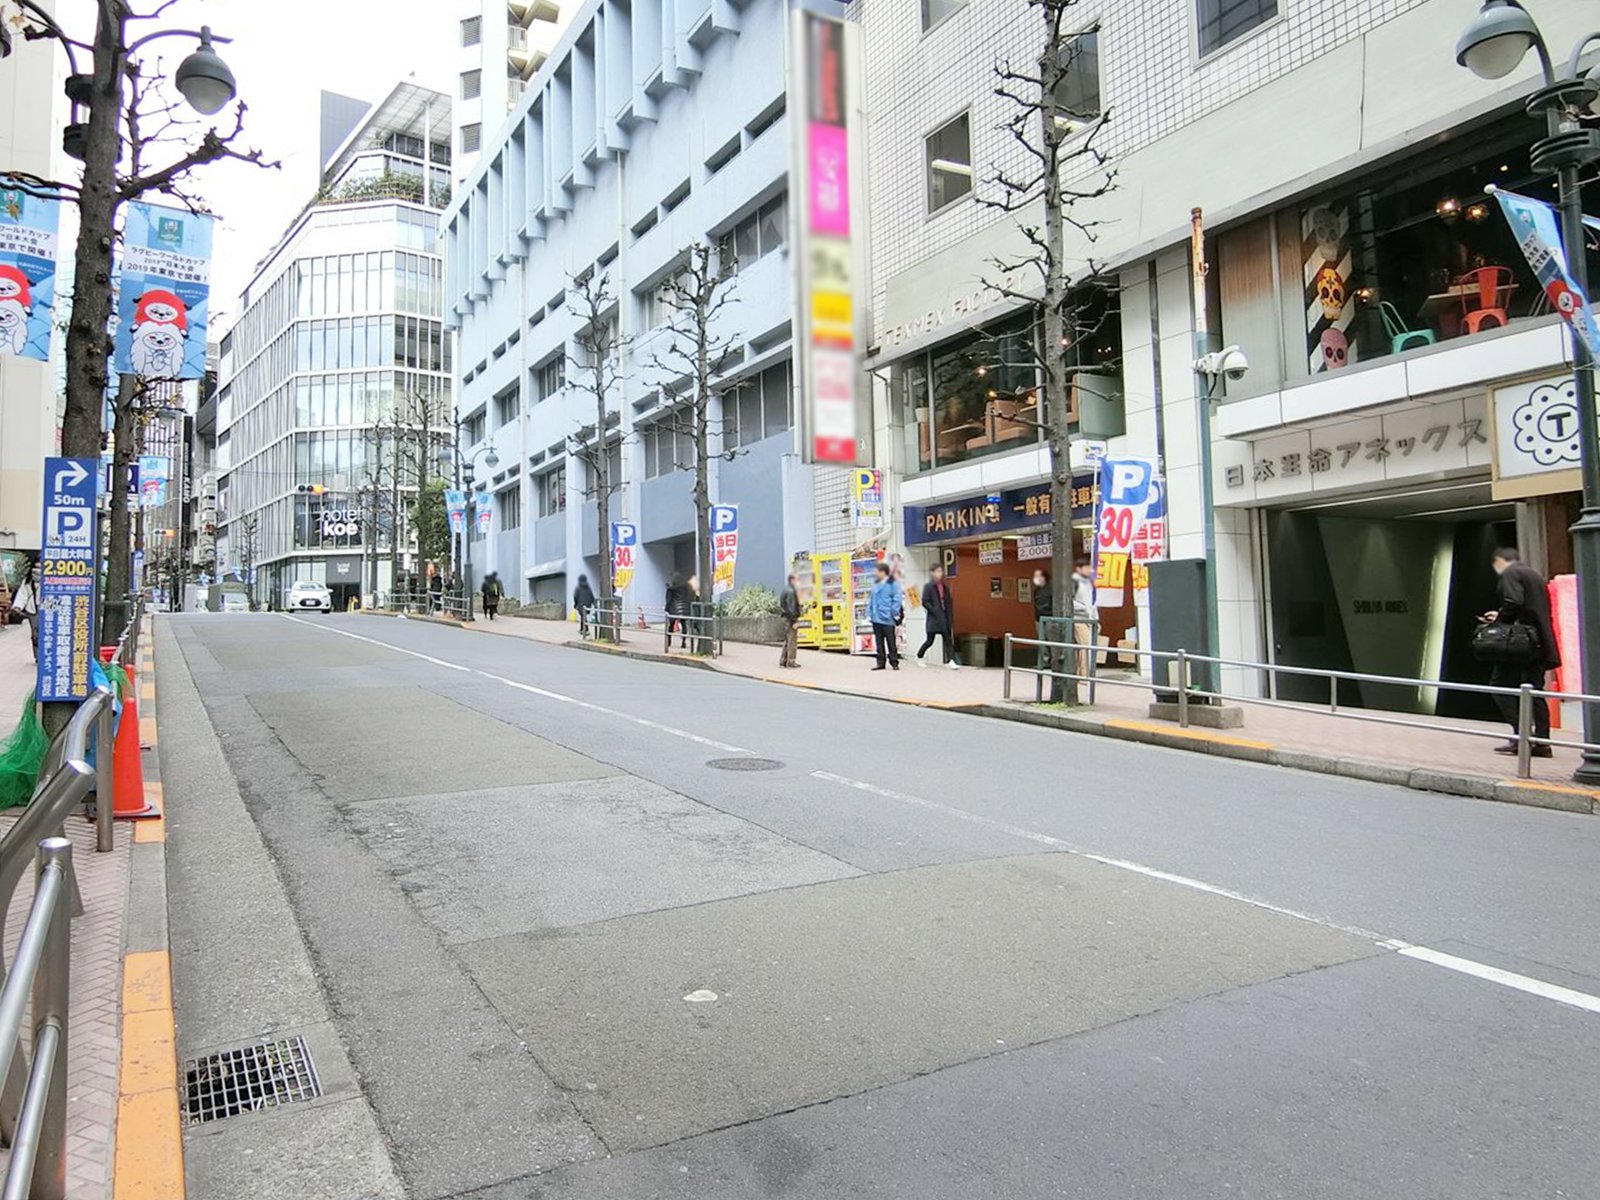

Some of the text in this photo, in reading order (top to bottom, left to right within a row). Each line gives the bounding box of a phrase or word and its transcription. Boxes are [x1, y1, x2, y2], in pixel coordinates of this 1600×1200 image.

[131, 246, 206, 266] ラグビーワールドカップ
[1547, 411, 1572, 437] T
[857, 469, 875, 501] P
[1110, 463, 1144, 500] P
[54, 494, 85, 505] 50m
[58, 511, 84, 547] P
[323, 520, 358, 536] koe
[716, 509, 734, 530] P
[68, 535, 87, 543] 24H
[618, 526, 634, 544] P
[944, 549, 955, 576] P
